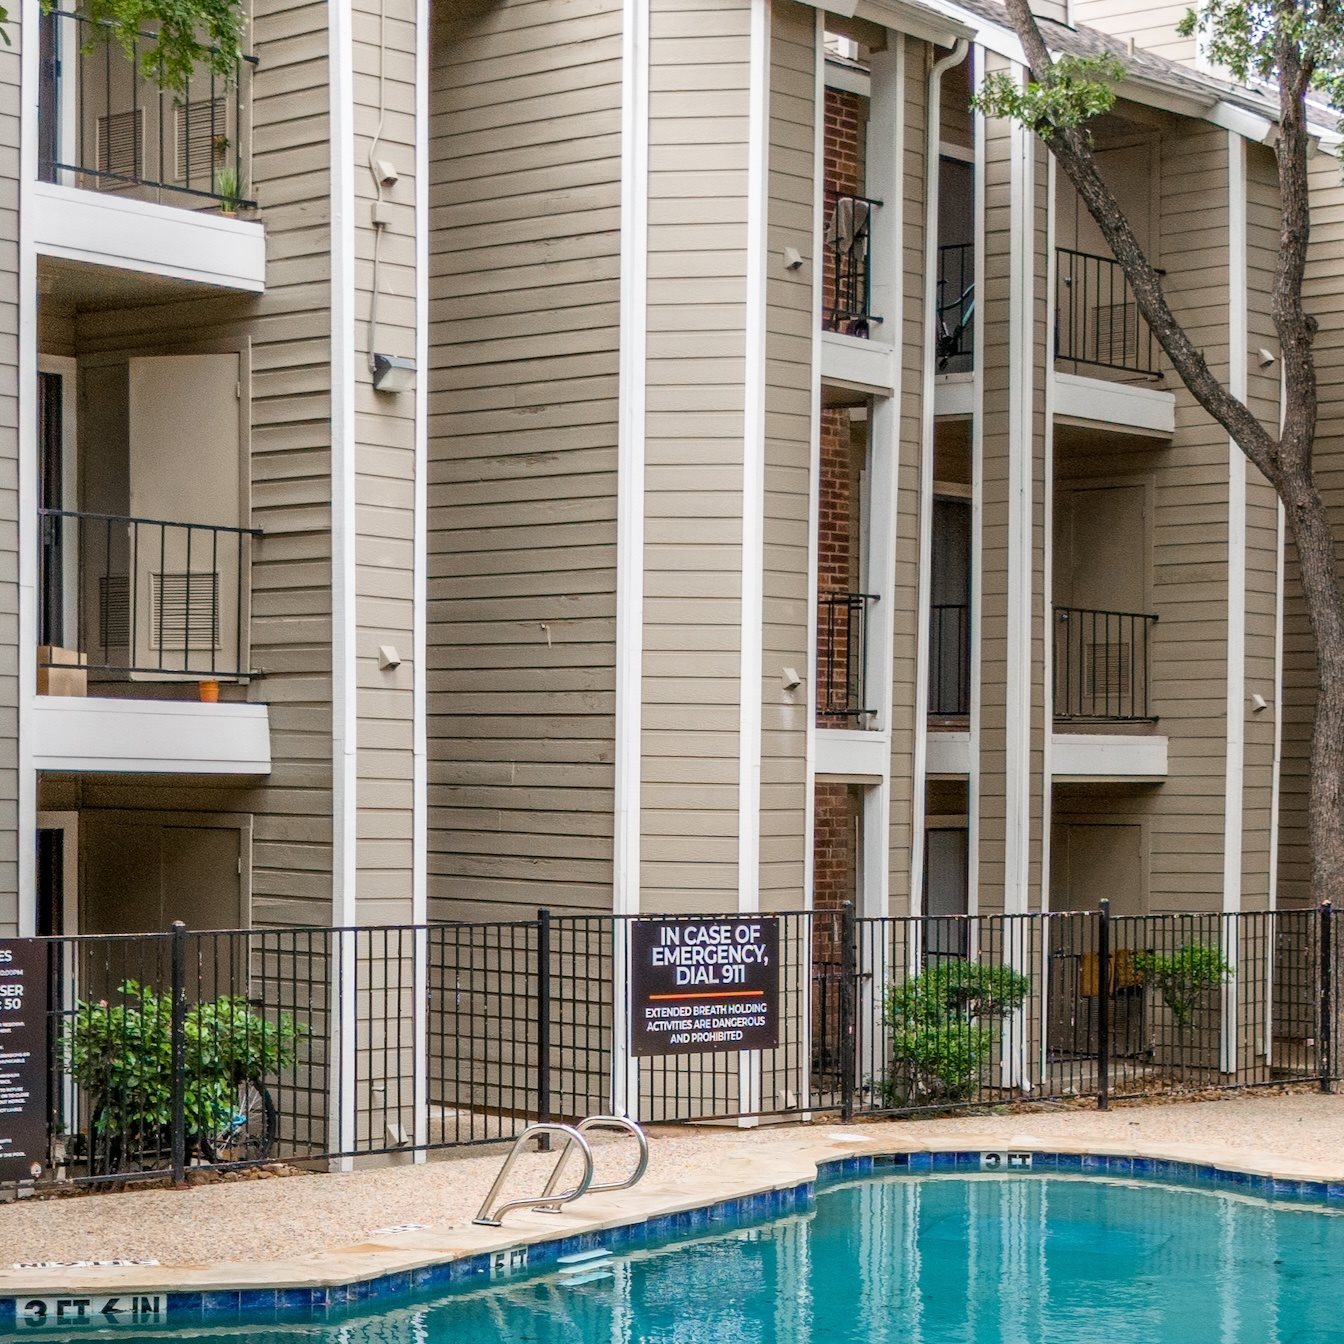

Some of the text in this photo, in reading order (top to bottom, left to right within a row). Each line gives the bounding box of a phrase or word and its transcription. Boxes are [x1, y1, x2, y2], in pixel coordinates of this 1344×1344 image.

[661, 925, 760, 945] IN CASE OF
[652, 944, 768, 966] EMERGENCY,
[676, 965, 745, 985] DIAL 911
[4, 999, 21, 1009] 50
[646, 1003, 767, 1018] EXTENDED BREATH HOLDING
[647, 1017, 765, 1032] ACTIVITIES ARE DANGEROUS
[670, 1031, 743, 1043] AND PROHIBITED
[24, 1300, 47, 1316] 3
[57, 1299, 90, 1315] FT
[132, 1297, 160, 1314] IN
